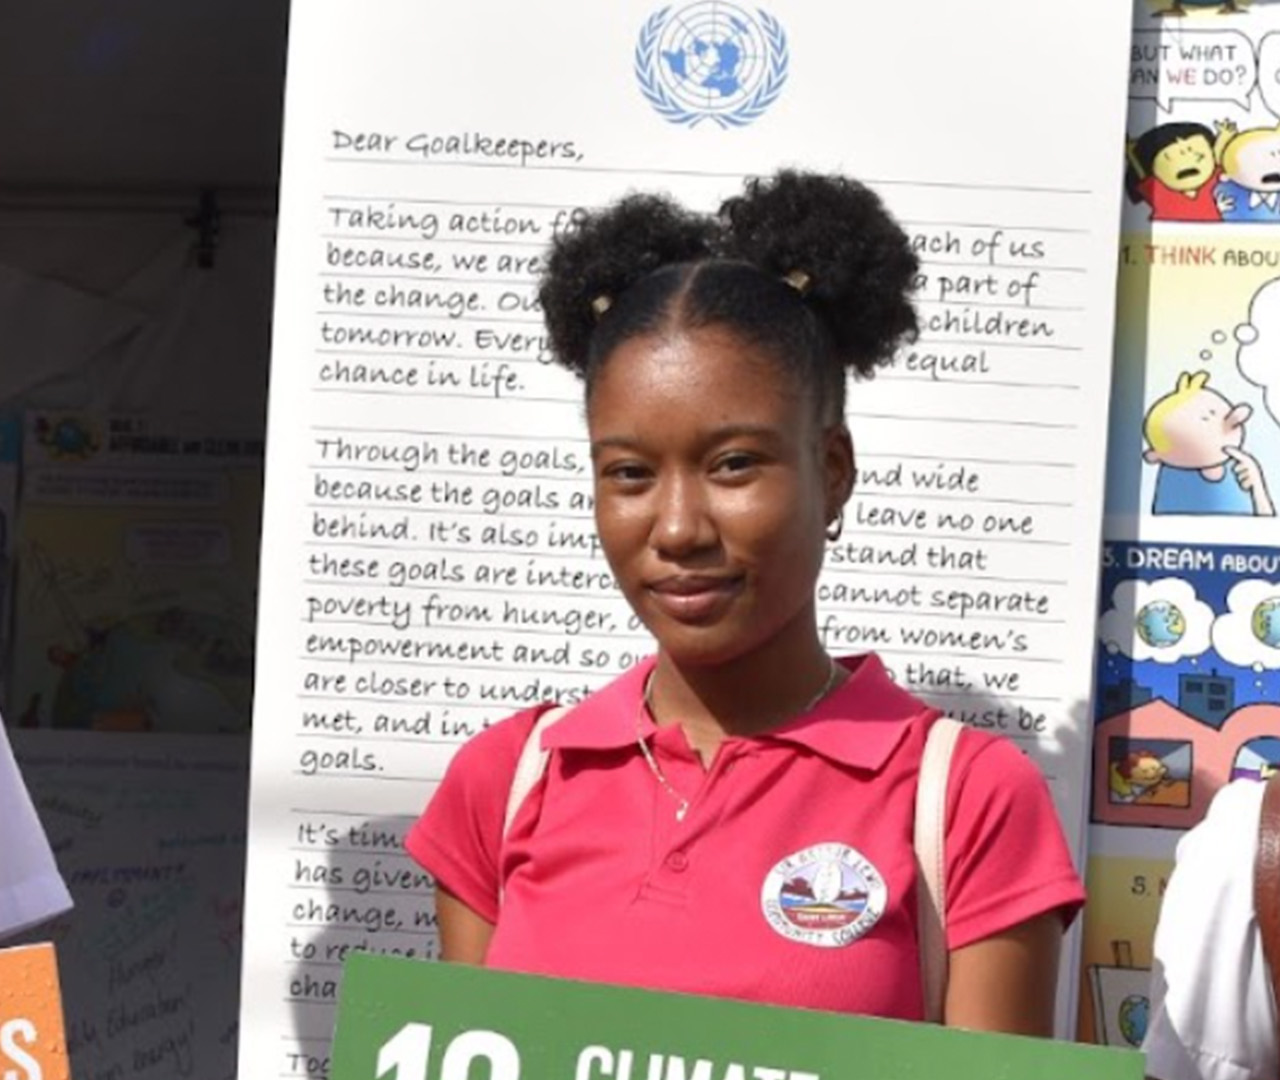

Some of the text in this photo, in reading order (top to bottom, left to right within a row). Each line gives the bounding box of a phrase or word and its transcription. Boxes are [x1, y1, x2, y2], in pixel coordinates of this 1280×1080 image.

[1132, 44, 1237, 62] BUT WHAT
[1132, 66, 1247, 86] AN WE DO?
[332, 130, 584, 166] Dear Goalkeepers,
[328, 204, 438, 240] Taking
[449, 207, 541, 234] action
[326, 242, 541, 274] because, we are
[910, 231, 1045, 265] ach of us
[1145, 245, 1216, 266] THINK
[323, 282, 542, 318] the change. Ou
[938, 275, 998, 302] part
[1007, 272, 1039, 306] of
[321, 321, 463, 348] tomorrow.
[928, 308, 1054, 337] children
[320, 360, 524, 398] chance in life.
[906, 350, 990, 381] equal
[315, 438, 584, 476] Through the goals,
[862, 463, 979, 492] nd wide
[315, 474, 595, 514] because the goals ar
[857, 502, 1034, 534] leave no one
[312, 512, 602, 559] behind. It's also imp
[310, 553, 616, 589] these goals are interc
[830, 544, 987, 571] stand that
[1128, 549, 1215, 571] DREAM
[305, 594, 411, 630] poverty
[420, 595, 493, 627] from
[503, 602, 617, 634] hunger,
[818, 583, 1049, 619] cannot separate
[818, 615, 1028, 652] from women's
[305, 634, 504, 664] empowerment
[513, 642, 569, 665] and
[579, 650, 610, 667] so
[304, 671, 590, 704] are closer to underst
[906, 663, 1020, 691] that, we
[302, 711, 472, 735] met, and in
[1019, 707, 1046, 731] be
[299, 747, 383, 775] goals.
[298, 824, 404, 848] It's tim
[295, 860, 436, 893] has given
[292, 898, 403, 932] change,
[290, 938, 316, 959] to
[289, 974, 336, 998] cha
